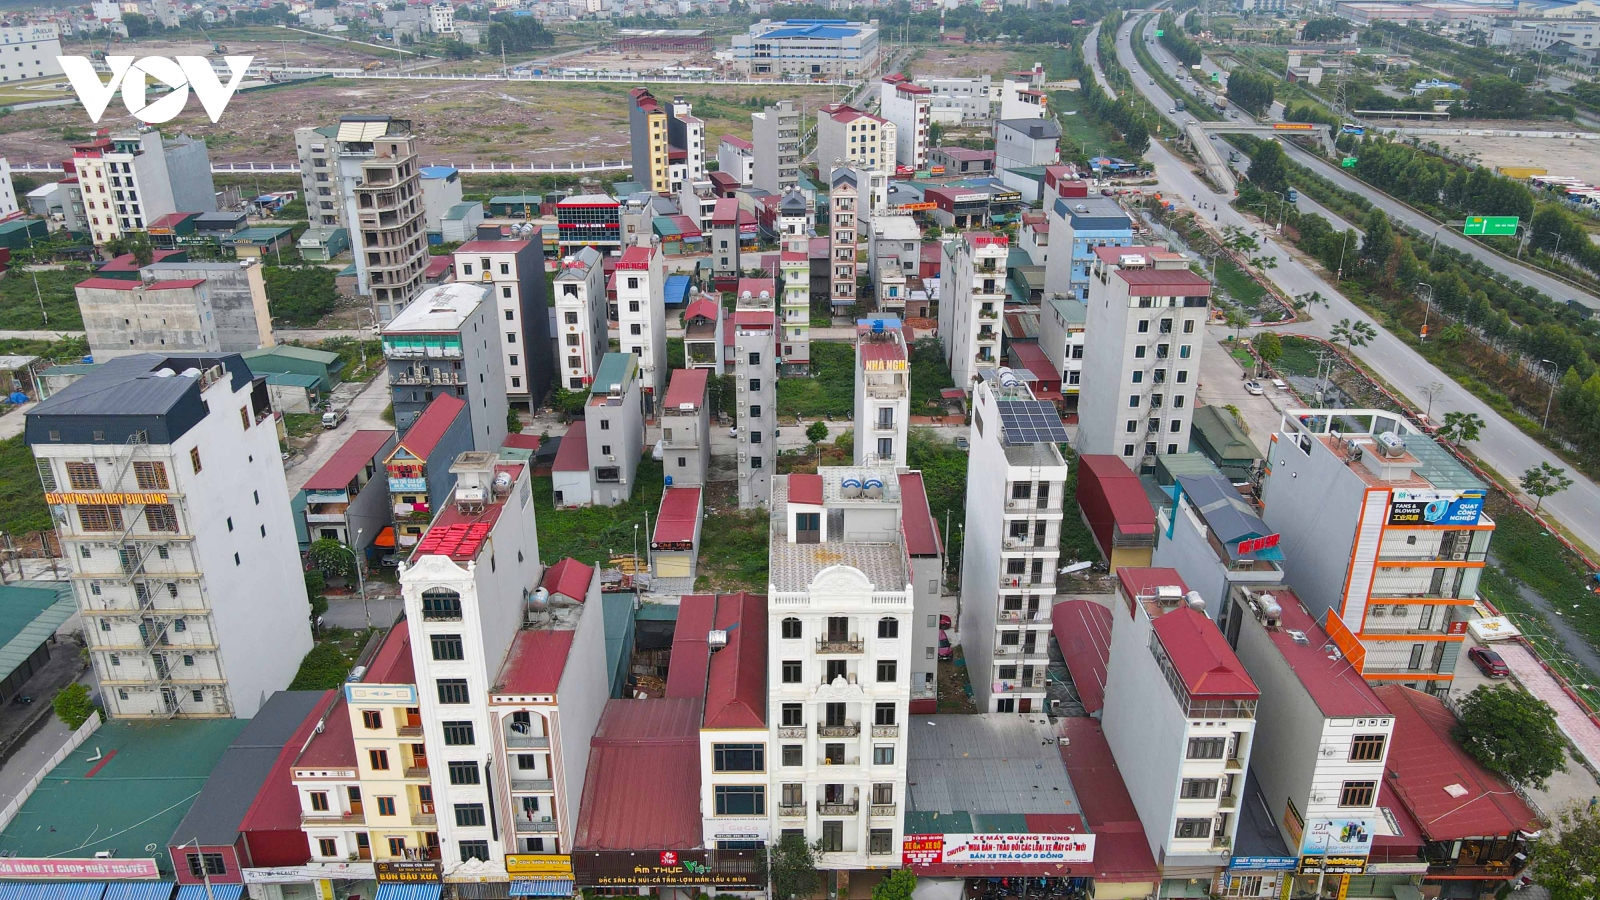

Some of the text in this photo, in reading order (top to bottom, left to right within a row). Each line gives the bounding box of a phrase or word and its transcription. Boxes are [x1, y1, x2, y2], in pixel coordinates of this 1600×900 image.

[866, 358, 884, 370] NHÀ
[46, 492, 168, 505] GIA HƯNG LUXURY BUILDING
[934, 840, 940, 849] SỐ
[982, 843, 992, 851] BÁN
[1021, 843, 1031, 851] CÁC
[1053, 843, 1064, 851] MÁY
[14, 862, 40, 872] HÀNG
[57, 864, 83, 874] CHỌN
[400, 873, 418, 881] ĐẬU
